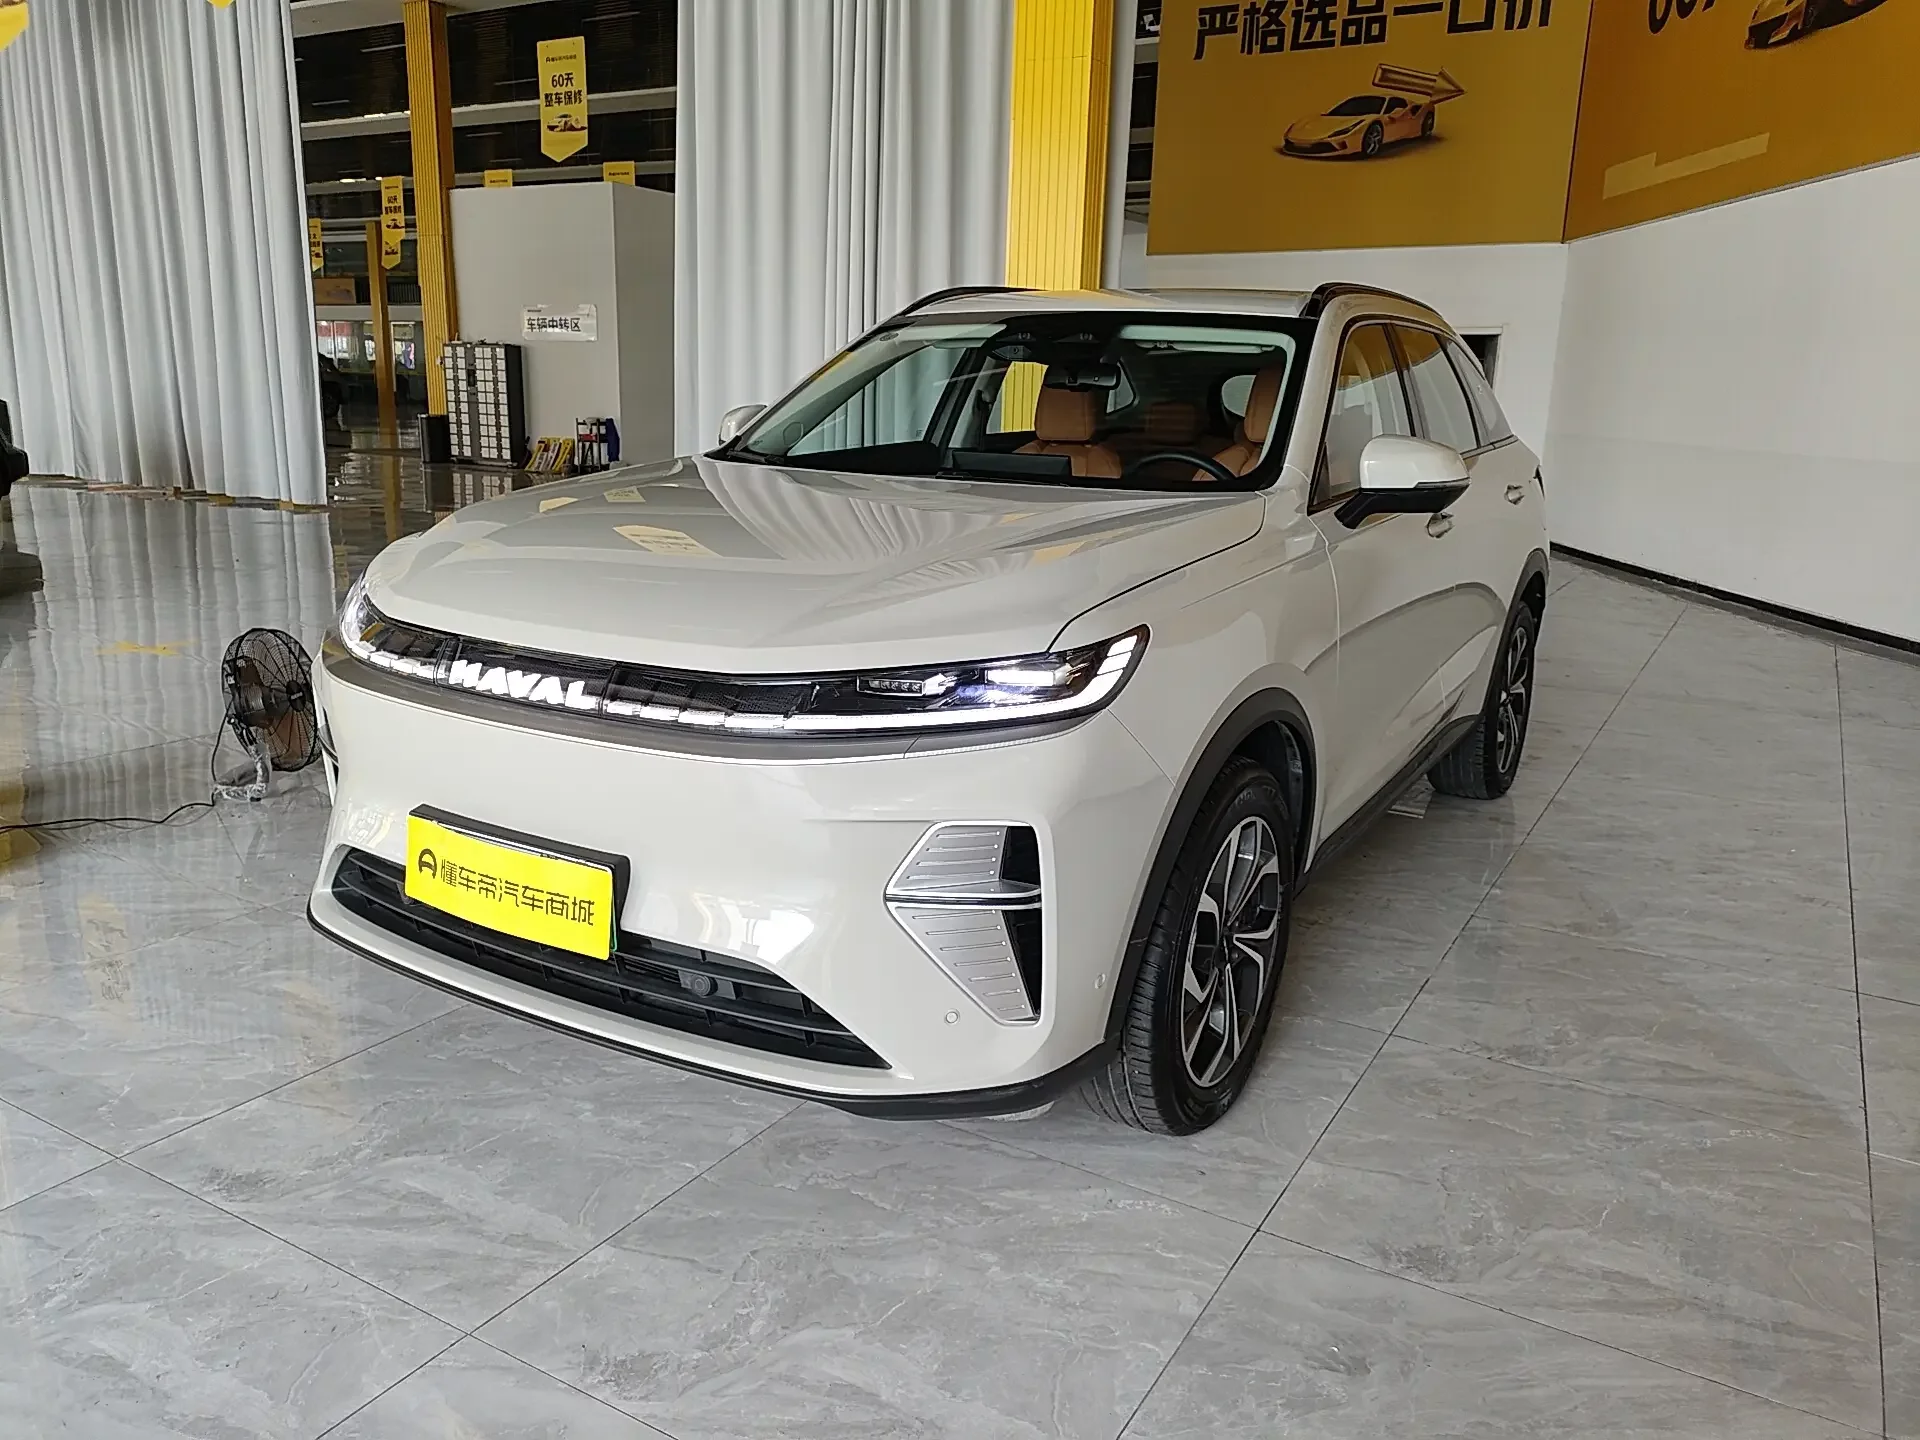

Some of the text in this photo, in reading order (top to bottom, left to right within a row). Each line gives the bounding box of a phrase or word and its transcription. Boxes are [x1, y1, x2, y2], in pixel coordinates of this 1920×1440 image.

[551, 72, 574, 88] 60天
[544, 89, 582, 107] 整车保修
[526, 317, 582, 333] 车辆中转区
[449, 659, 598, 710] HAVAL
[441, 858, 595, 926] 懂车帝汽车商城
